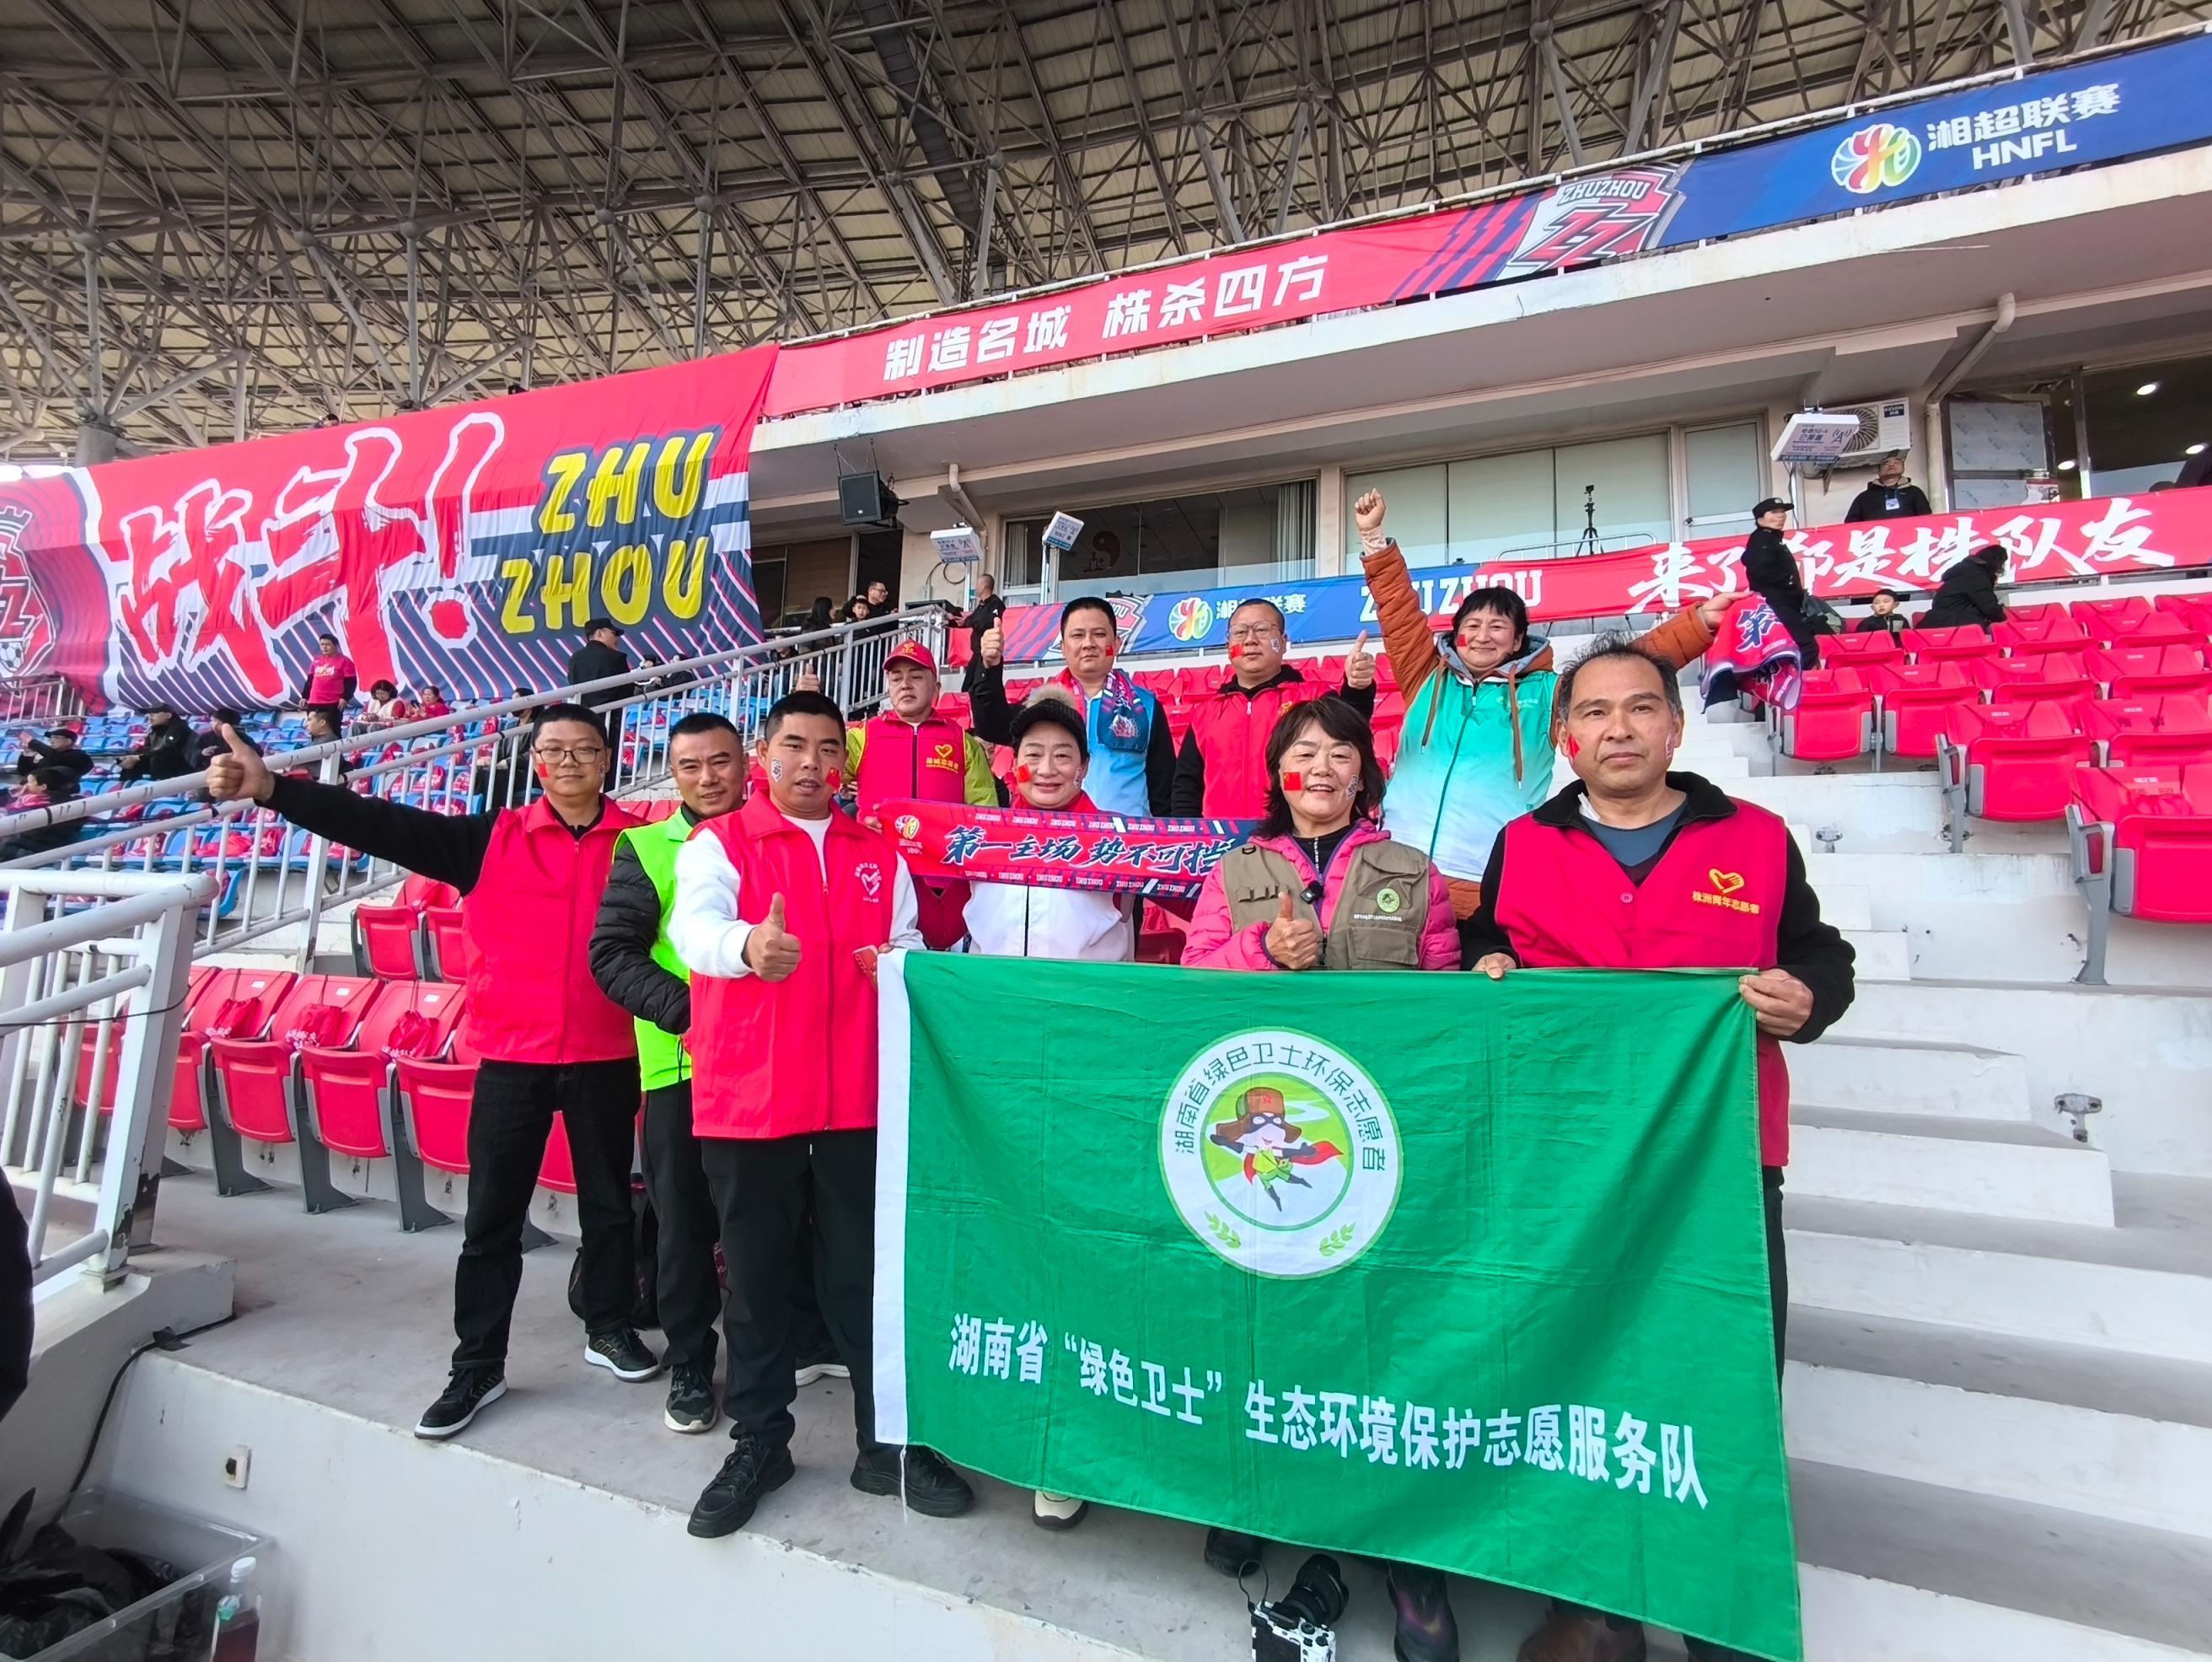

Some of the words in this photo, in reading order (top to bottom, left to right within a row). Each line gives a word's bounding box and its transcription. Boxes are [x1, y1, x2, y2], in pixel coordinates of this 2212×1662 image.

[1926, 83, 2121, 152] 湘超联赛
[1972, 129, 2077, 169] HNFL
[1558, 179, 1651, 205] ZHUZHOU
[883, 304, 1072, 381] 制造名城
[1101, 254, 1330, 339] 株杀四方
[539, 432, 714, 534] ZHU
[501, 536, 709, 633] ZHOU
[1216, 594, 1307, 620] 湘赛
[1360, 569, 1543, 622] ZUZU
[940, 825, 1083, 865] 第一主场
[1069, 836, 1236, 876] 势不可挡
[1174, 1042, 1386, 1172] 湖南省绿色卫士环保志愿者
[948, 1313, 1049, 1385] 湖南省
[1063, 1332, 1223, 1426] “绿色卫士”
[1244, 1379, 1710, 1510] 生态环境保护志愿服务队
